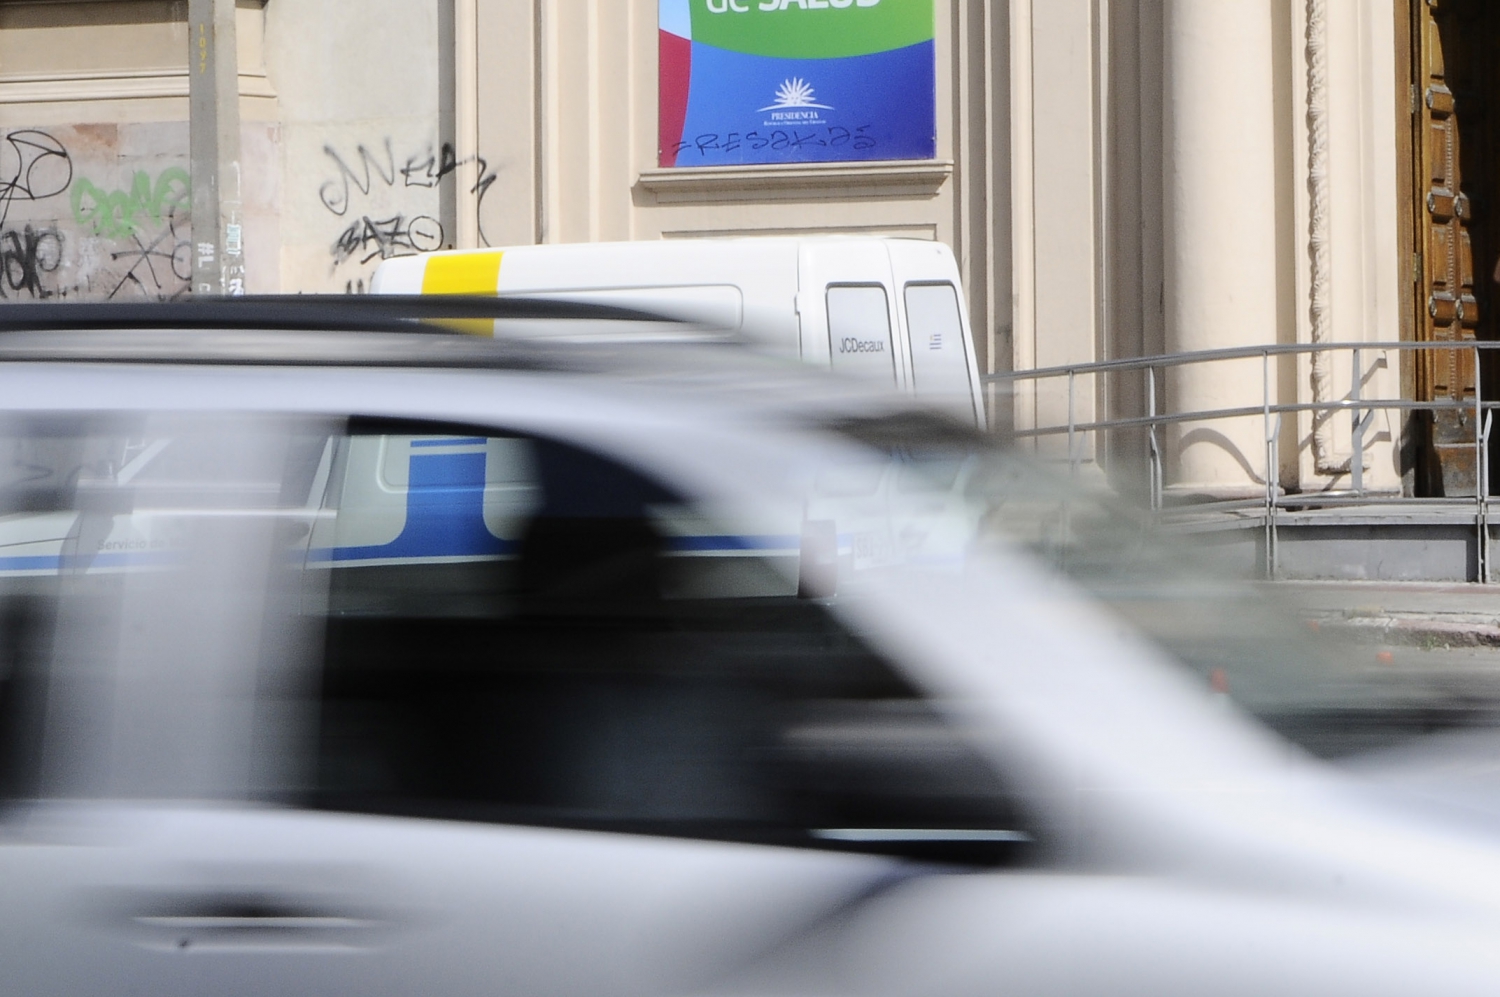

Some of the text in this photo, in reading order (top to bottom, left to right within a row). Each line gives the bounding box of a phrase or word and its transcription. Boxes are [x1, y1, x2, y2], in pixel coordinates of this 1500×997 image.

[771, 111, 819, 121] PRESIDENCIA
[839, 337, 885, 353] JCDecaux
[97, 537, 147, 551] Servicio
